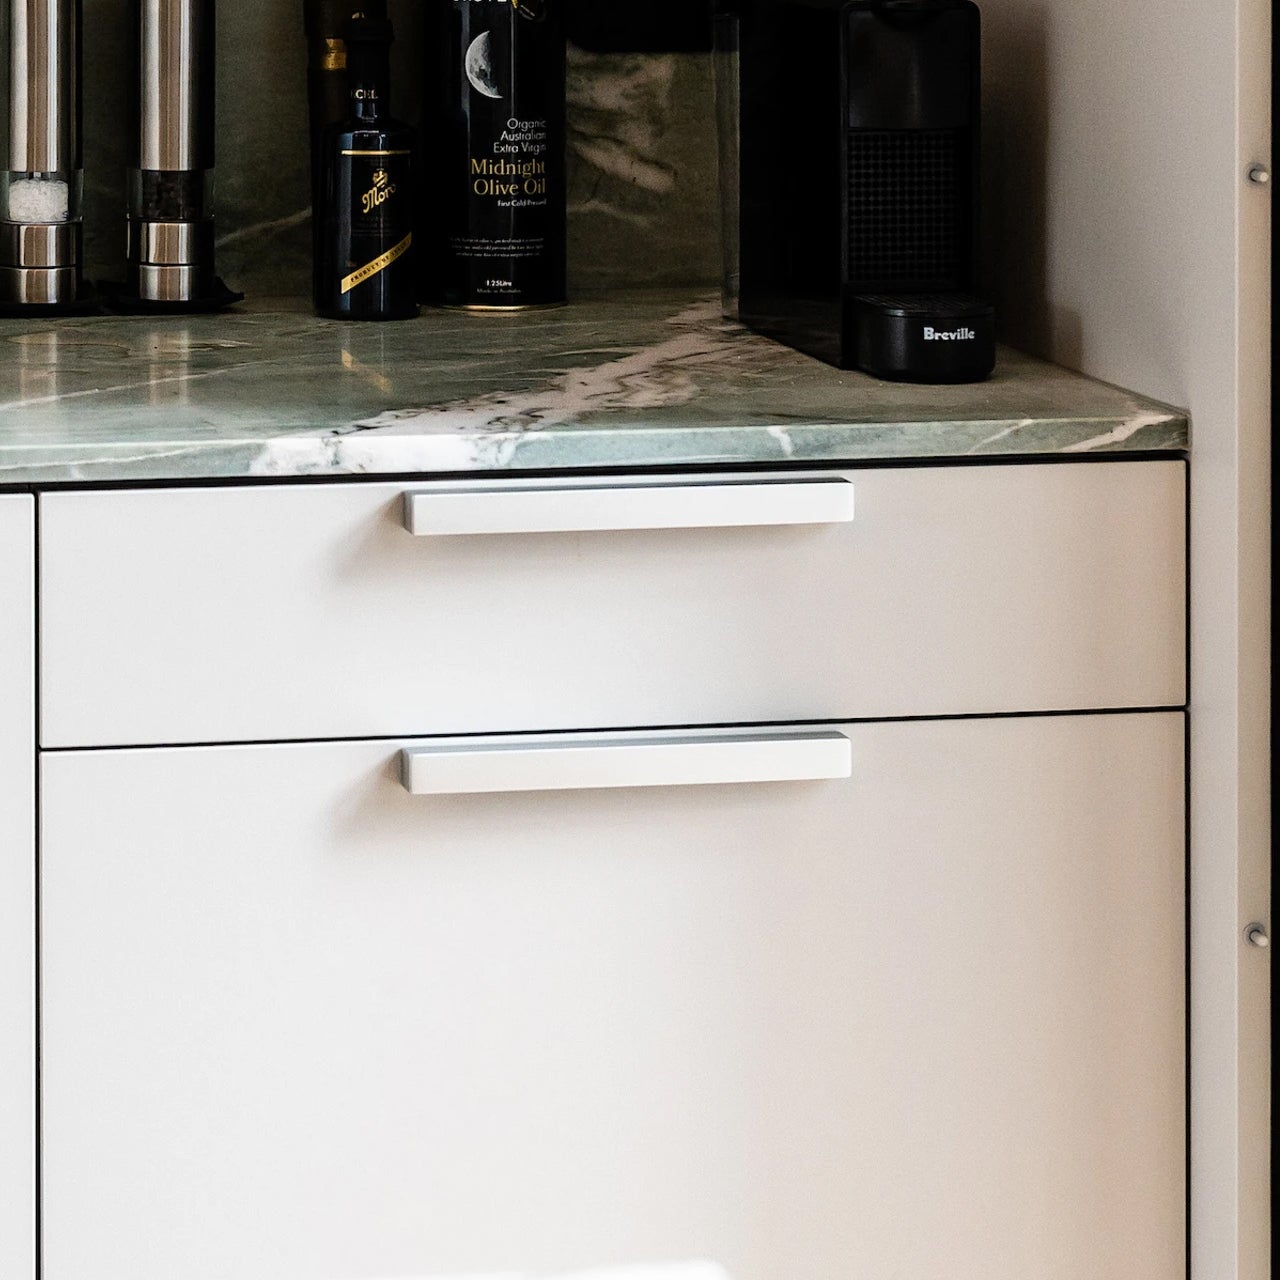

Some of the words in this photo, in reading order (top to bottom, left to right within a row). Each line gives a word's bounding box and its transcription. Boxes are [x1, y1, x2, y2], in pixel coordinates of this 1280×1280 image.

[506, 117, 546, 131] Organic
[500, 129, 546, 141] Australian
[493, 141, 519, 153] Extra
[520, 141, 546, 155] Virgin
[471, 158, 545, 178] Midnight
[473, 178, 519, 195] Olive
[523, 178, 546, 195] Oil
[923, 326, 976, 341] Breville
